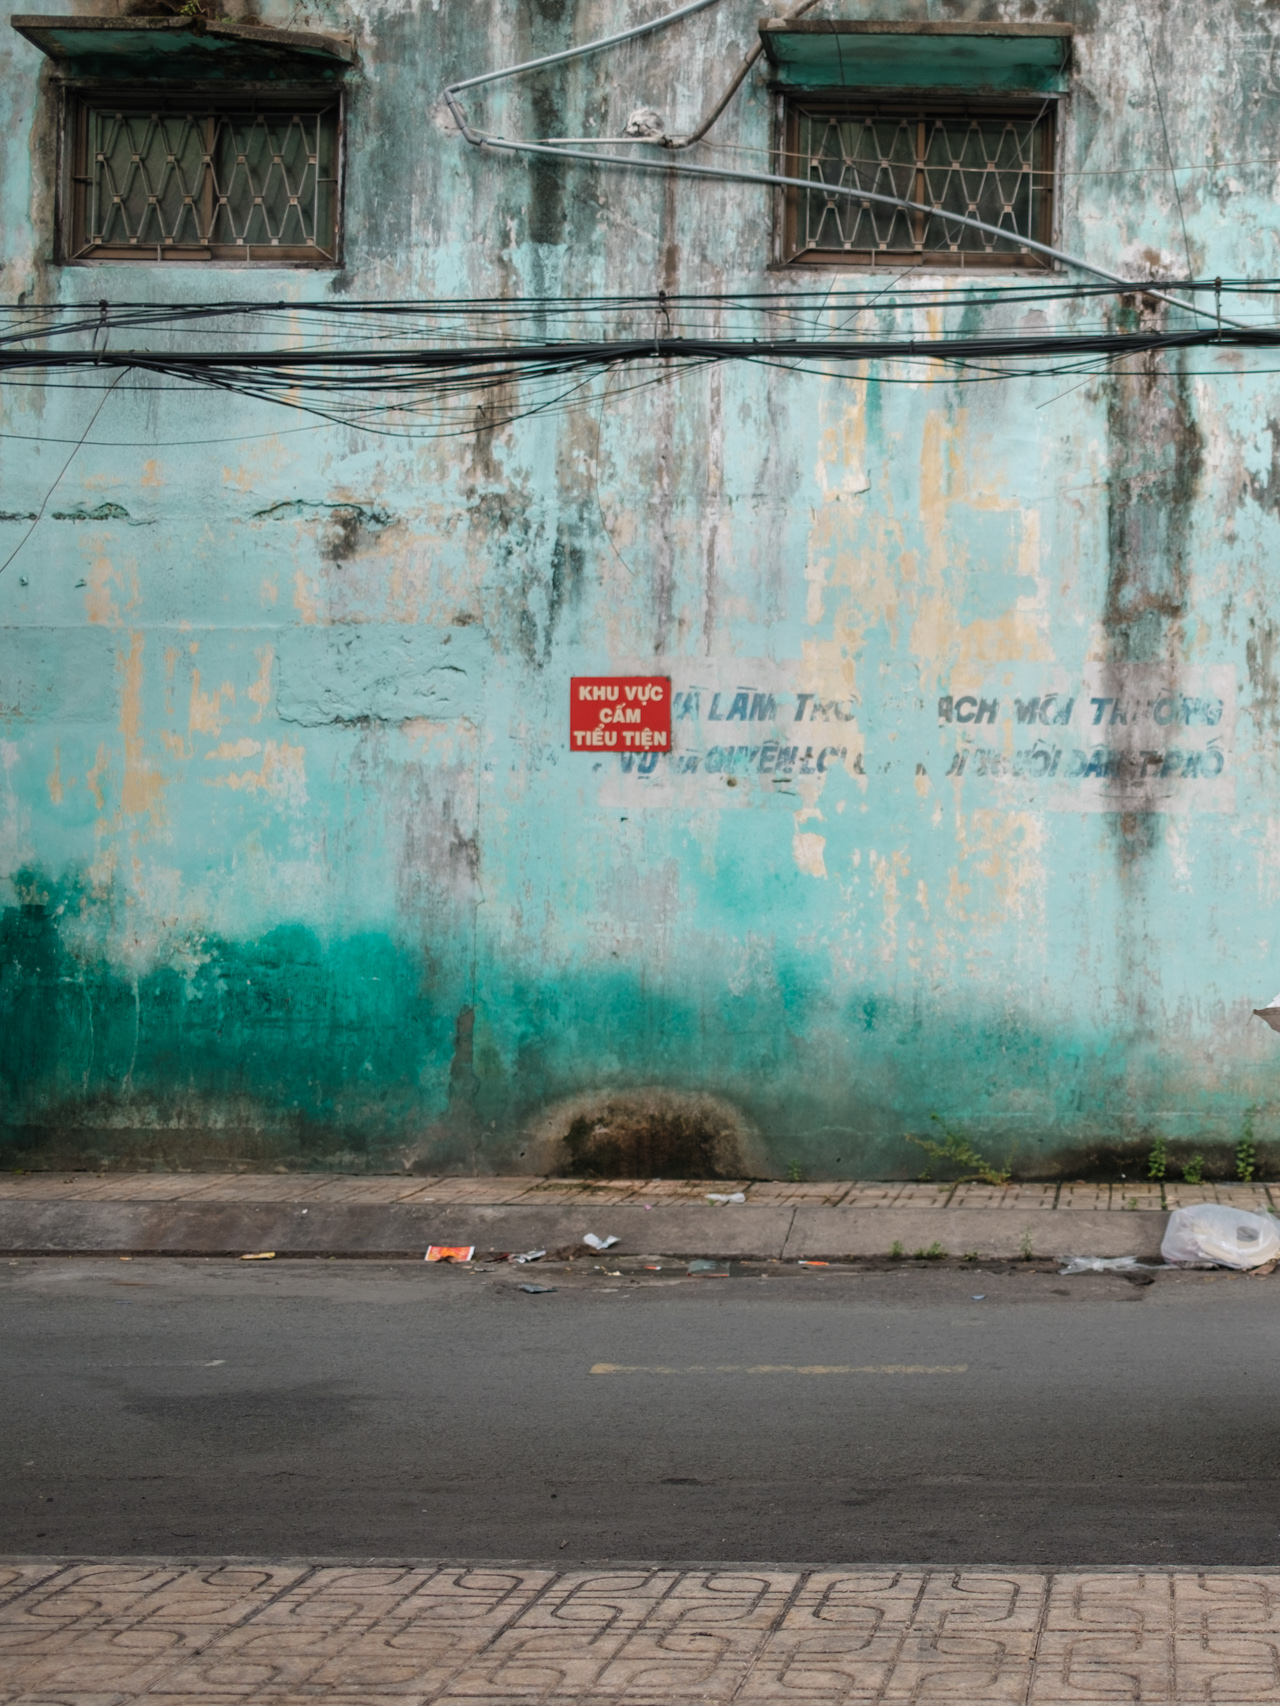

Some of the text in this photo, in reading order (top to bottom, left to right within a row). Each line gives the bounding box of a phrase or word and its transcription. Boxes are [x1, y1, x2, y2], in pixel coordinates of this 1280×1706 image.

[579, 683, 664, 706] KHU VỰC
[599, 704, 642, 724] CẤM
[573, 723, 667, 748] TIỂU TIỆN
